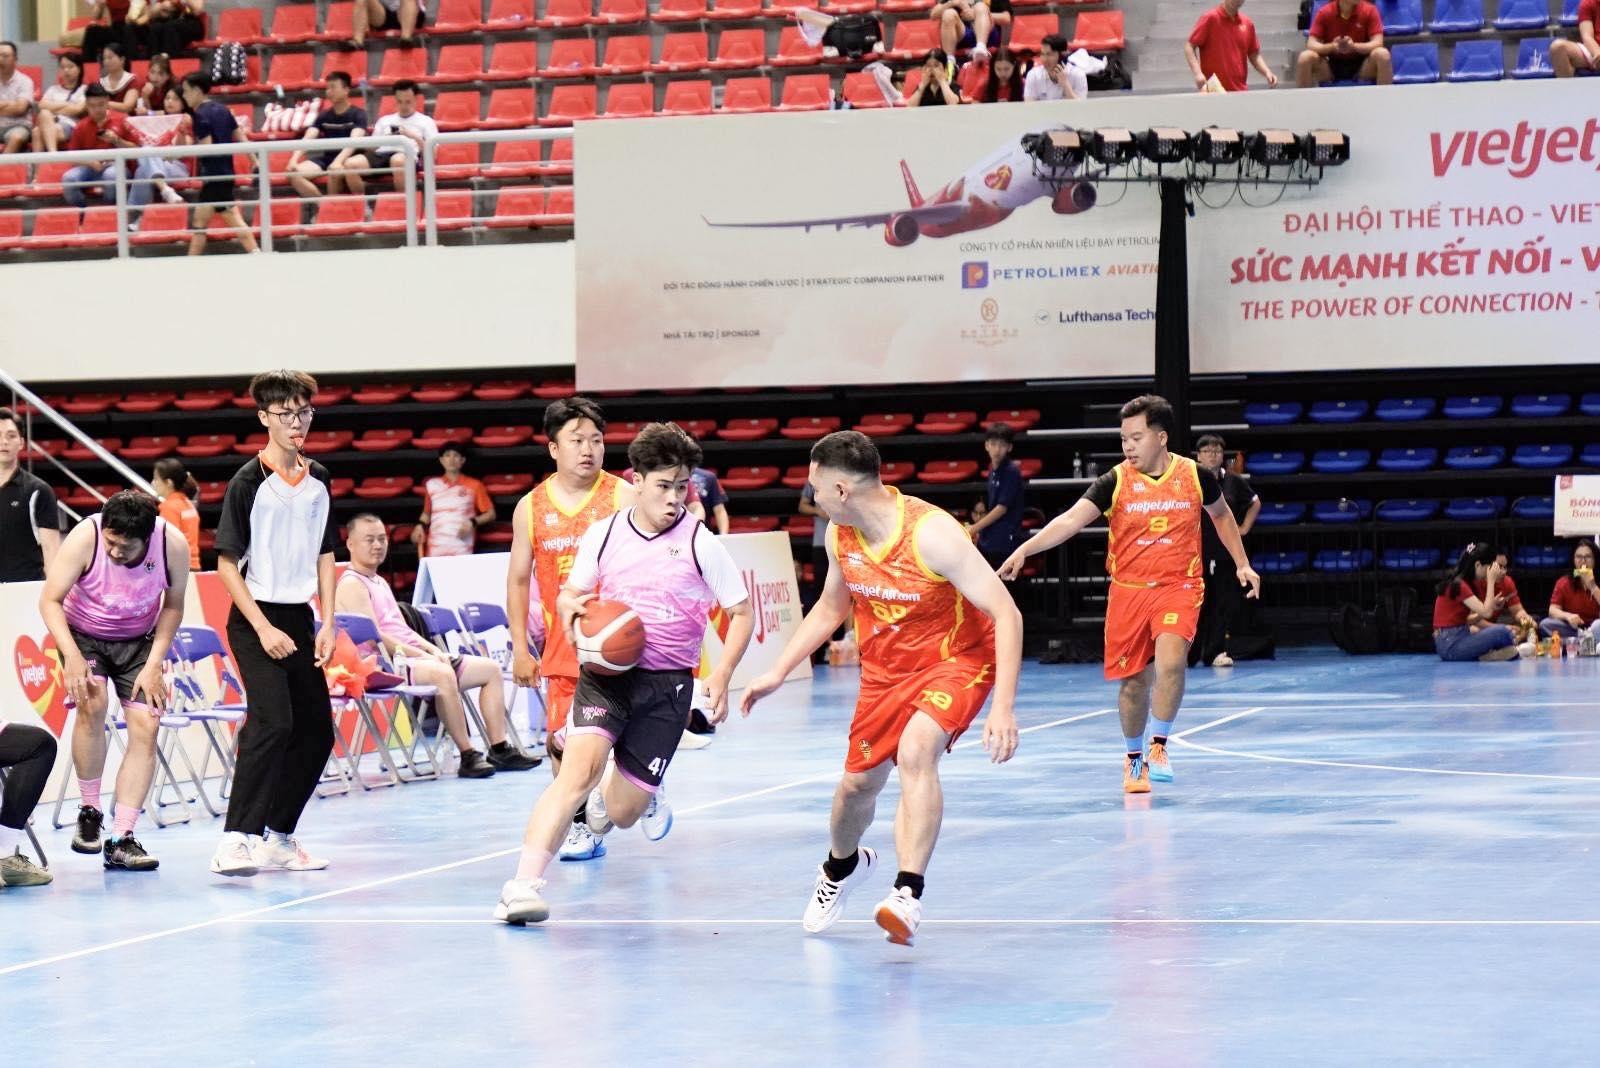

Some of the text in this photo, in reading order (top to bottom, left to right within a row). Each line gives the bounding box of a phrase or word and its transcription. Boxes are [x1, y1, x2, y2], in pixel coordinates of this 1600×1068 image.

[1283, 212, 1328, 237] ĐẠI
[1336, 205, 1382, 235] HỘI
[1390, 201, 1441, 229] THỂ
[1449, 205, 1524, 228] THAO
[1230, 247, 1293, 285] SỨC
[1300, 251, 1408, 288] MẠNH
[1416, 236, 1481, 278] KẾT
[1488, 234, 1552, 276] NỐI
[854, 274, 905, 285] COMPANION
[906, 272, 945, 283] PARTNER
[993, 264, 1101, 280] PETROLIMEX
[1241, 300, 1284, 321] THE
[1291, 297, 1377, 319] POWER
[1384, 296, 1414, 316] OF
[1419, 291, 1573, 315] CONNECTION
[1059, 307, 1157, 324] Lufthansa Tech
[721, 328, 760, 338] SPONSOR
[648, 756, 667, 776] 41
